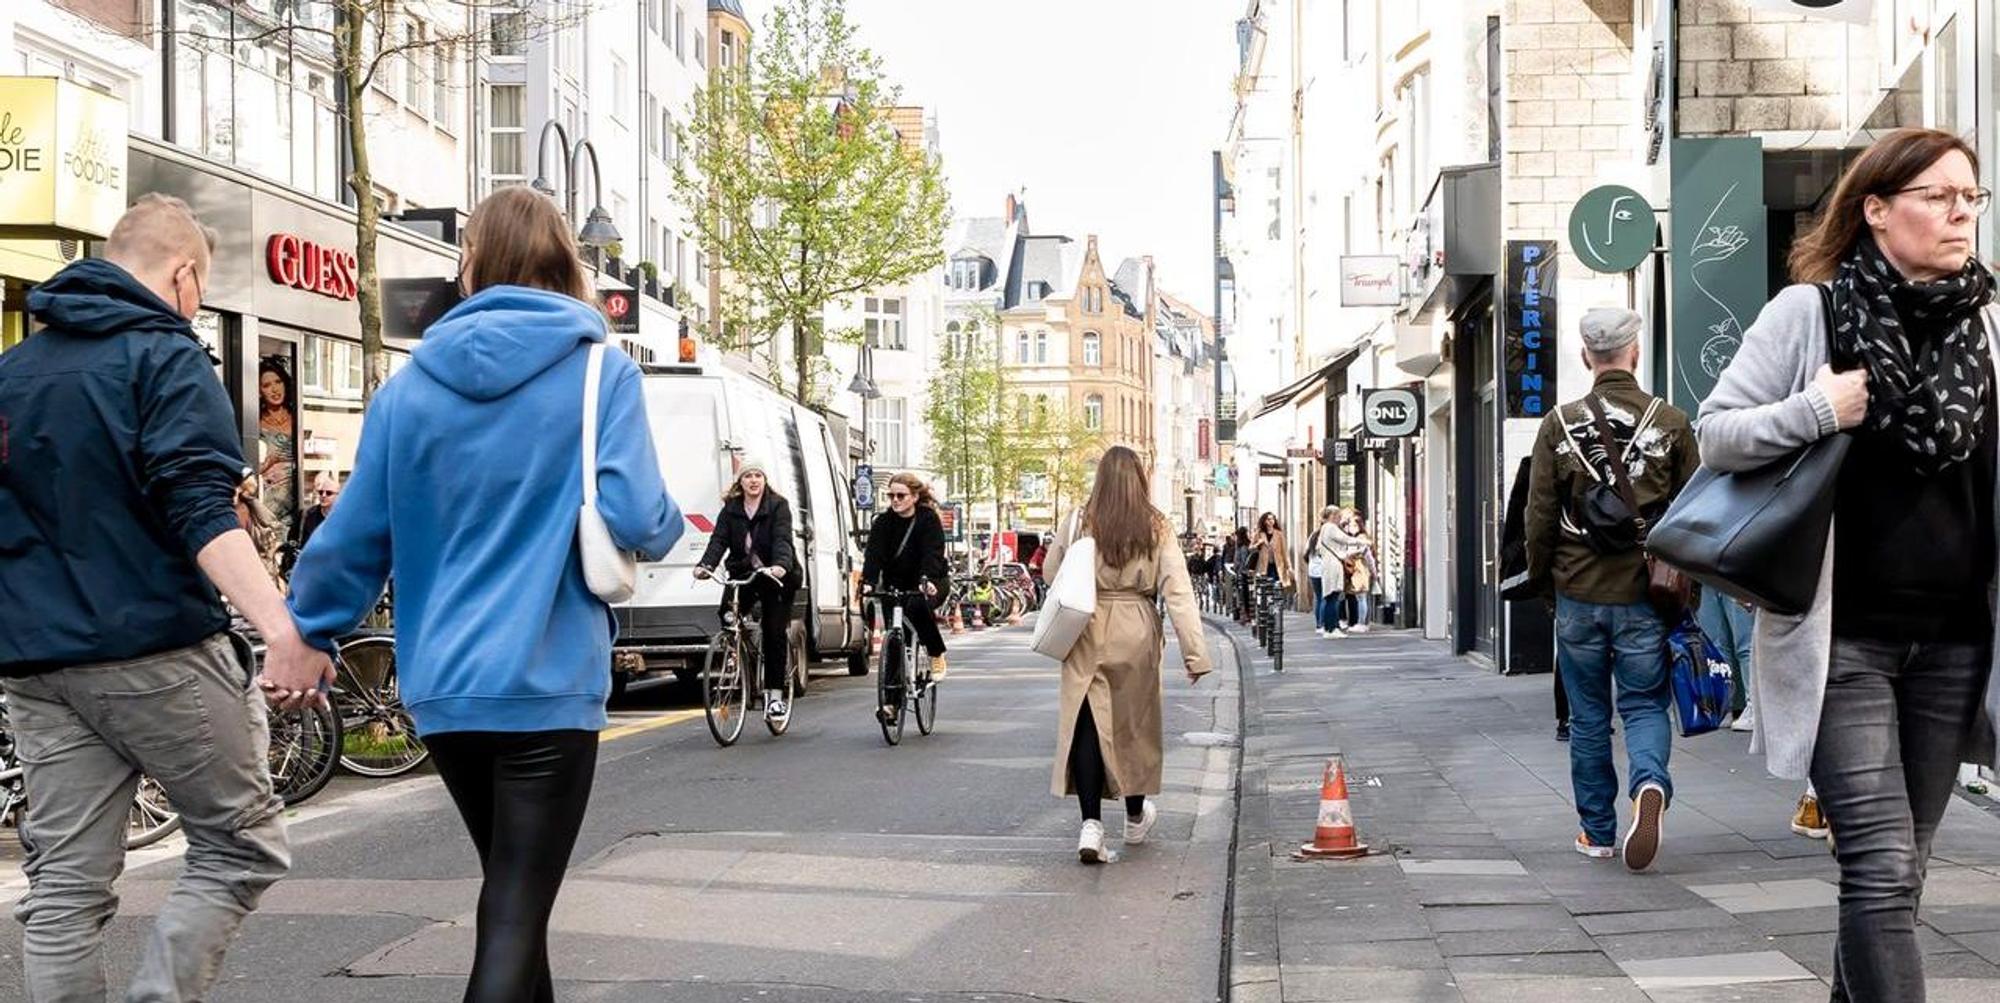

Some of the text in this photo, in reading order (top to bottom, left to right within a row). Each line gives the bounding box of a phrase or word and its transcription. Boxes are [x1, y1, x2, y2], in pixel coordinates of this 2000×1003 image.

[64, 152, 119, 190] FOODIE
[265, 233, 358, 301] GUESS
[1522, 246, 1542, 413] PIERCING
[1369, 406, 1414, 420] ONLY
